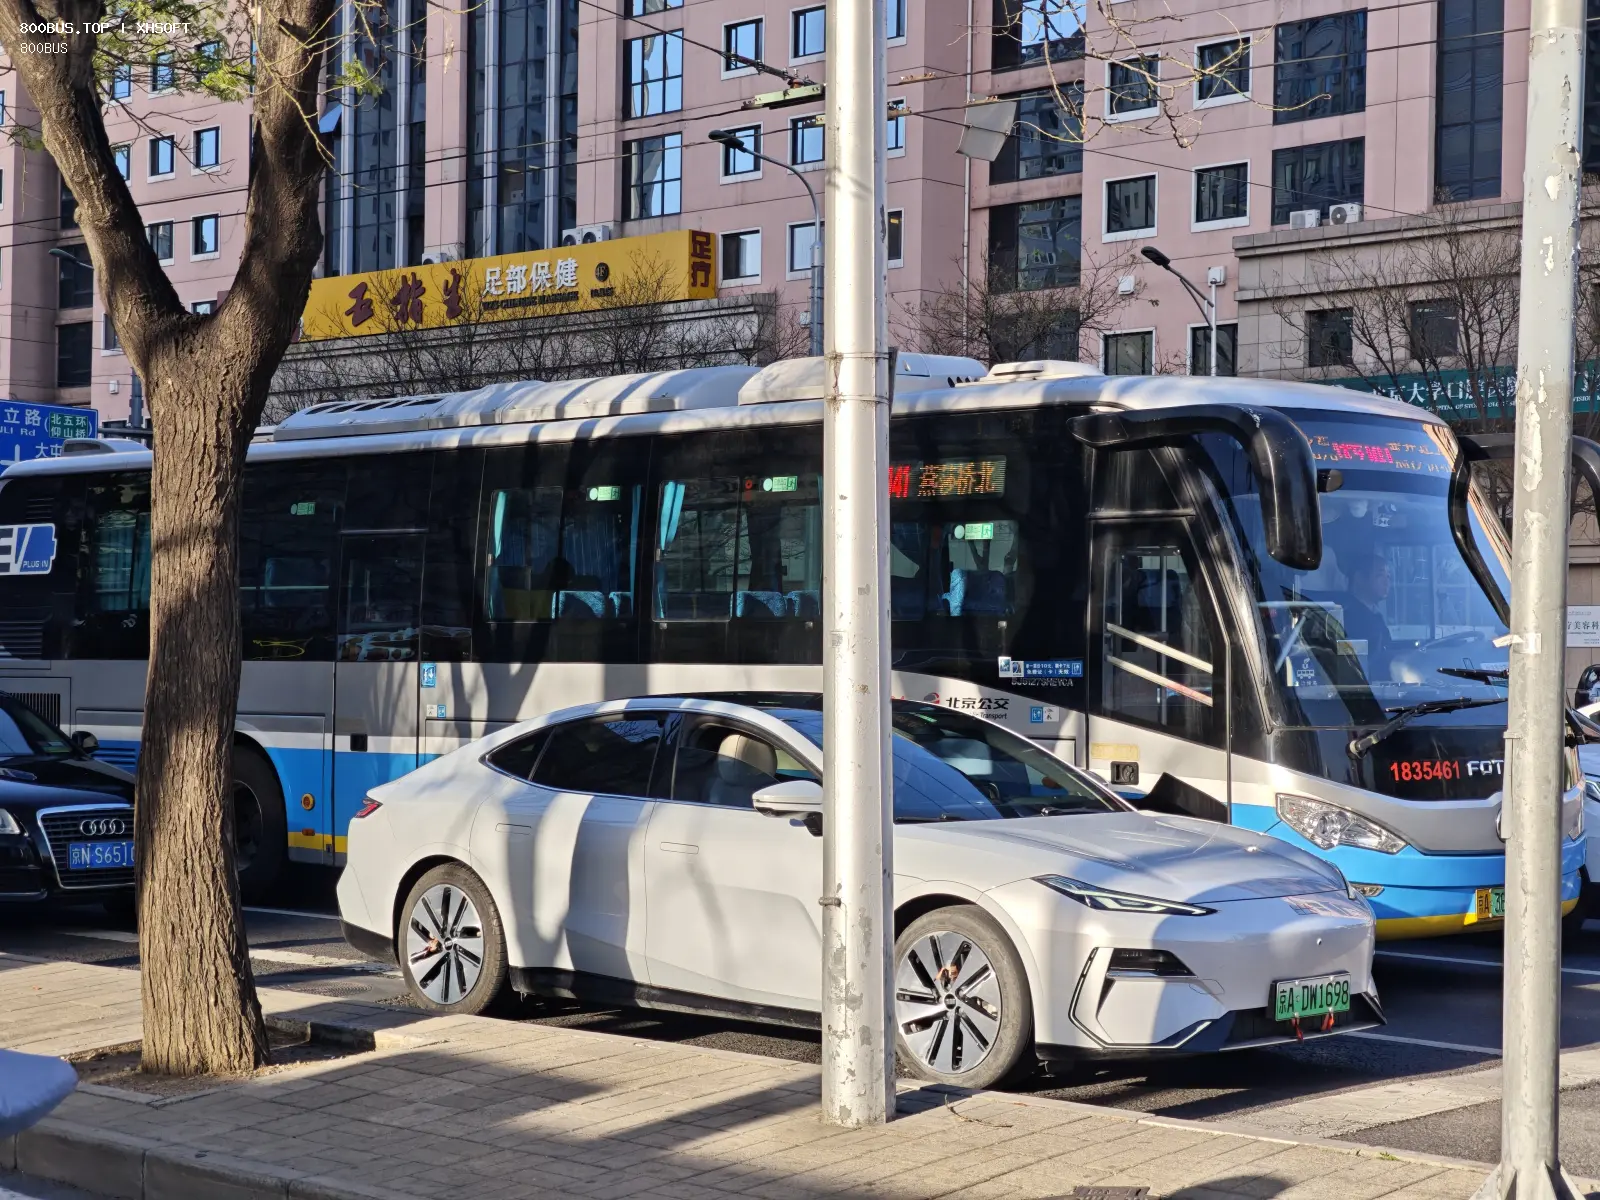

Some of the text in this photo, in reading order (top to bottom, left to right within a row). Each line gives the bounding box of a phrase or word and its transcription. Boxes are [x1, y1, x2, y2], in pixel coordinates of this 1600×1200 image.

[691, 230, 711, 287] 足疗
[482, 257, 579, 298] 足部保健
[51, 414, 87, 427] 北五环
[20, 428, 36, 437] Rd
[945, 697, 1010, 710] 北京公交
[1390, 760, 1460, 781] 1835461
